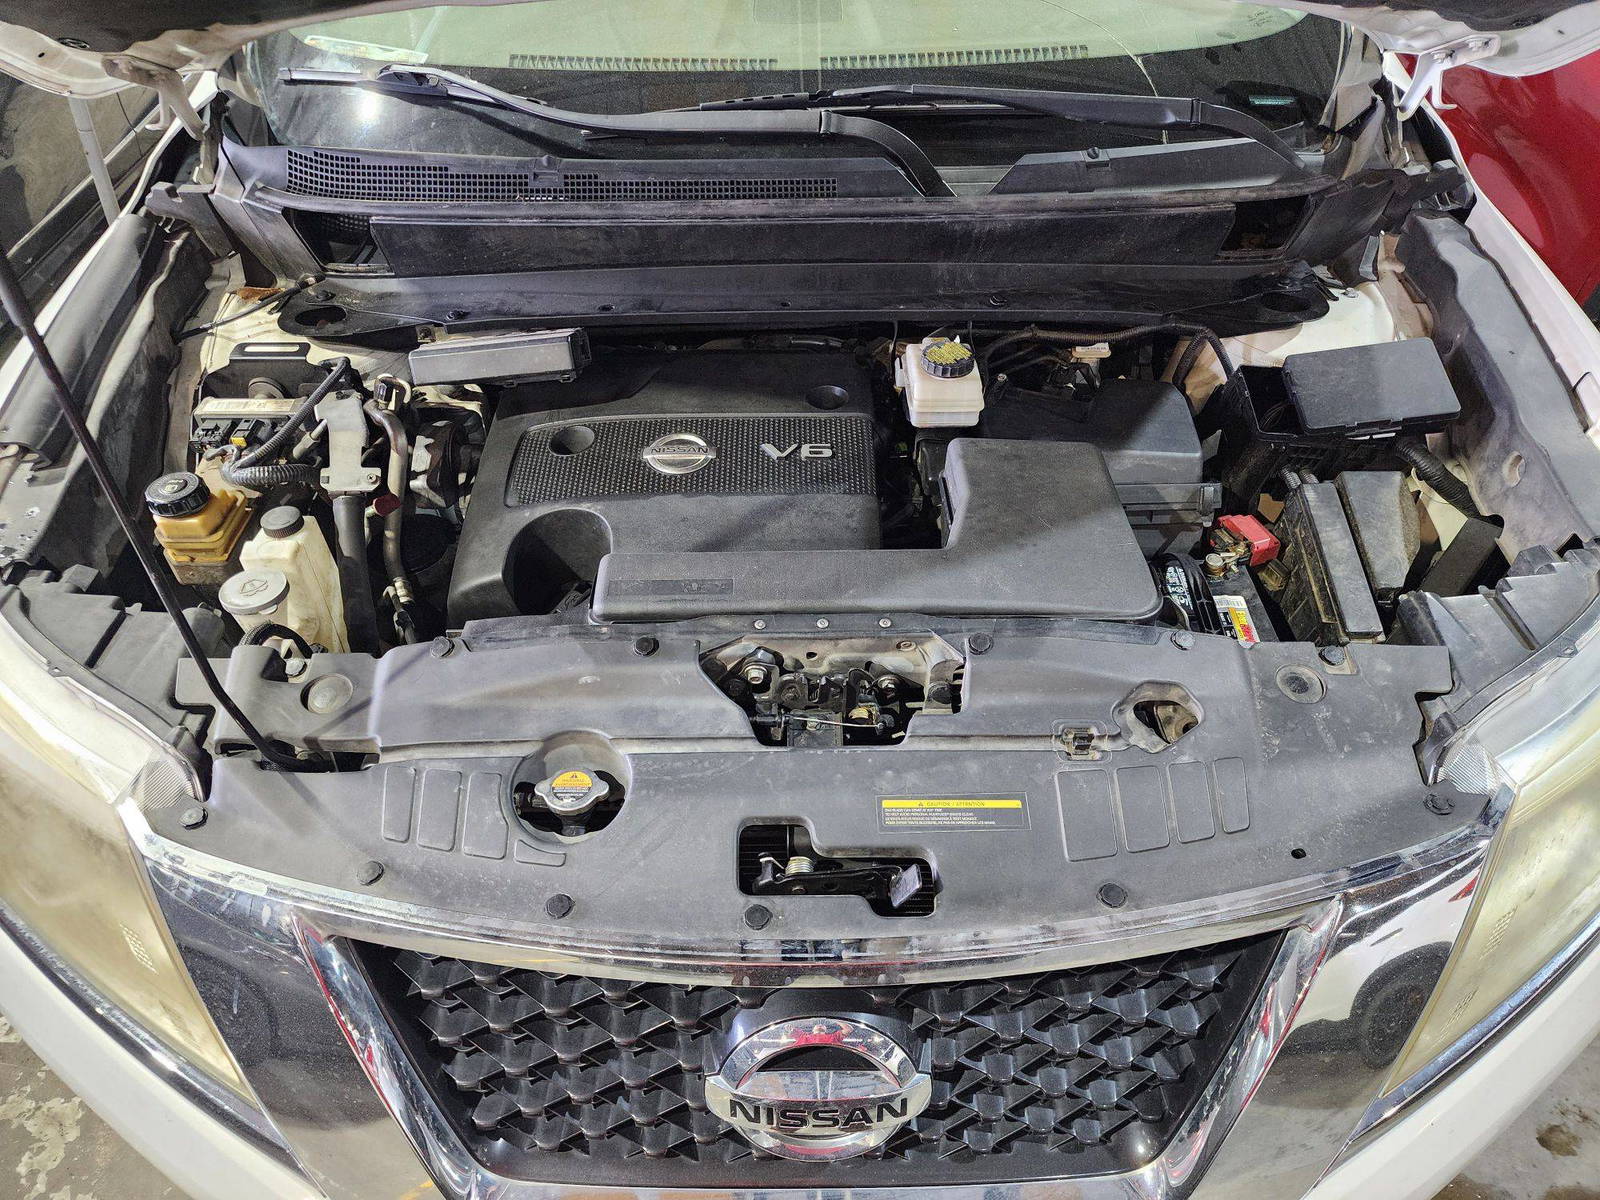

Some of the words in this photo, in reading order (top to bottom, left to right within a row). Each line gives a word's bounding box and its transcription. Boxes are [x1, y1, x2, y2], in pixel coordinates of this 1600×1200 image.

[650, 446, 709, 454] NISSAN
[760, 443, 833, 461] V6
[729, 1097, 908, 1129] NISSAN
